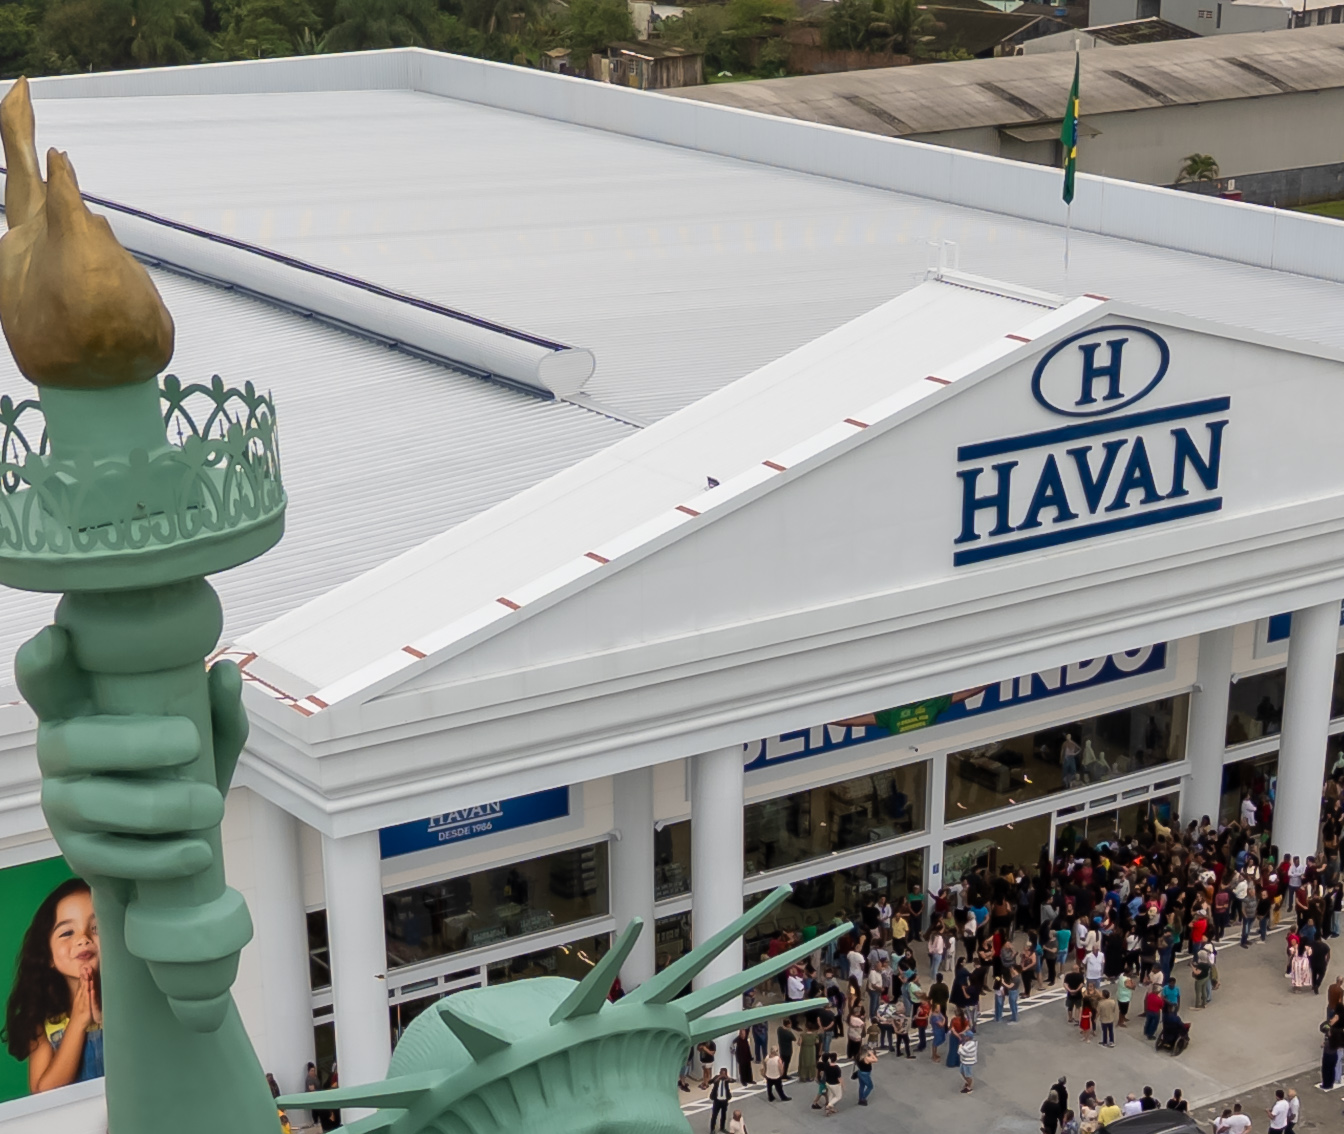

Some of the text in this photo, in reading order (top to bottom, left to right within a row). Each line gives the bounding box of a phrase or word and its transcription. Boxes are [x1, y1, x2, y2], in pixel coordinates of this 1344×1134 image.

[1074, 338, 1129, 406] H
[953, 419, 1229, 545] HAVAN
[438, 821, 493, 841] DESDE 1986
